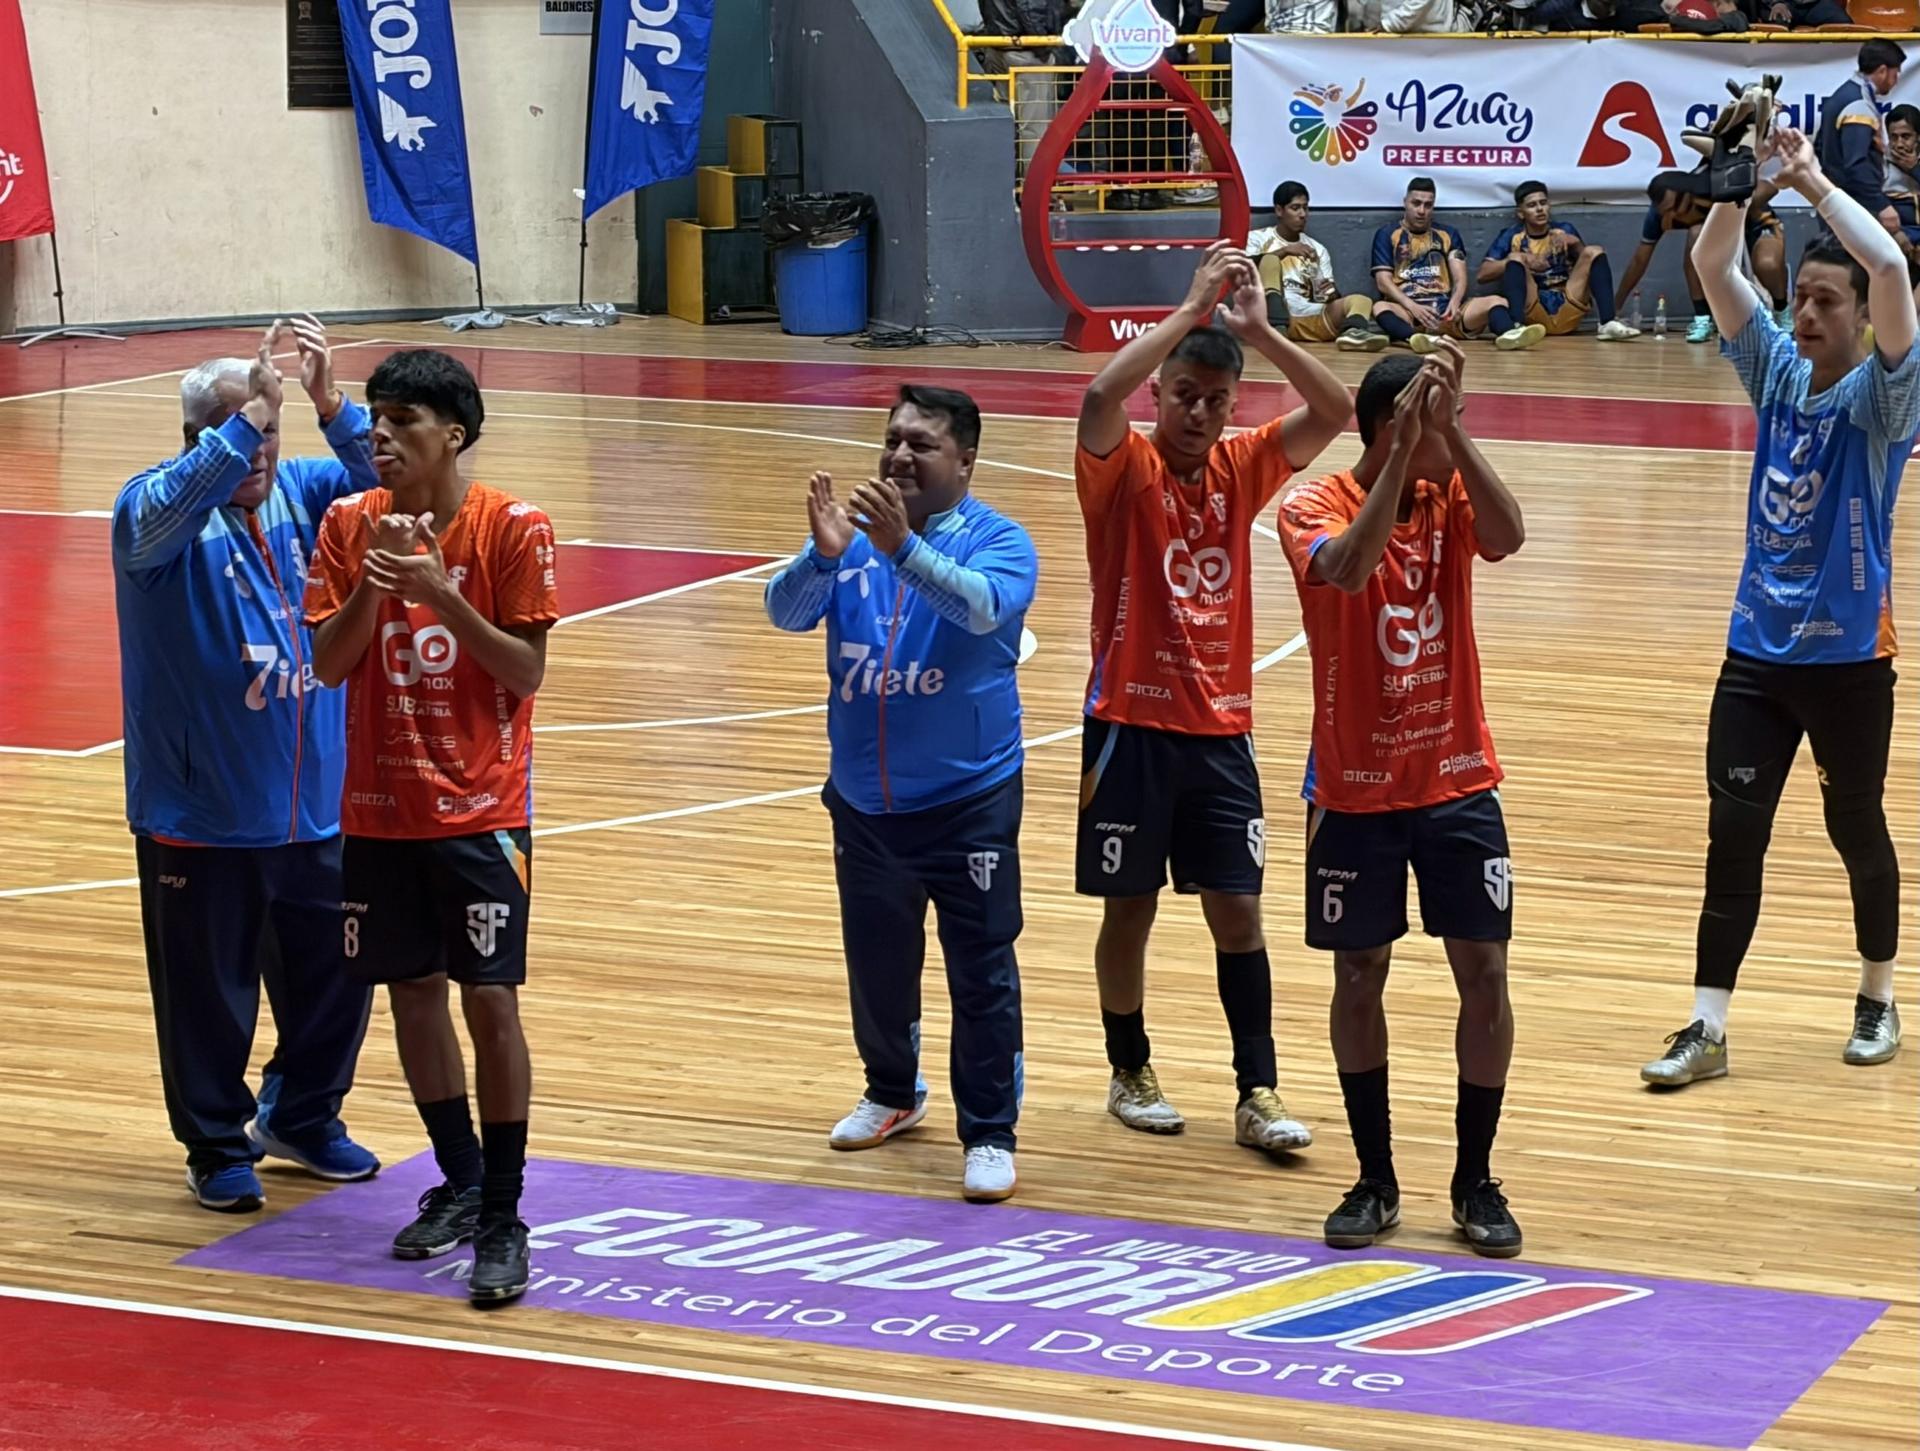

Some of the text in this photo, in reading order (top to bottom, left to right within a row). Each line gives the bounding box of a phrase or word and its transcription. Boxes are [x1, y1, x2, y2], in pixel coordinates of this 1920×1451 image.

[367, 0, 432, 89] JO
[1099, 24, 1171, 44] Vivant
[1386, 149, 1530, 164] PREFECTURA
[839, 642, 944, 703] 7iete
[1095, 822, 1137, 833] RPM
[1102, 837, 1122, 874] 9
[1317, 867, 1359, 881] RPM
[1323, 883, 1344, 924] 6
[344, 917, 359, 957] 8
[997, 1230, 1312, 1275] EL NUEVO
[870, 1313, 1016, 1346] del
[1029, 1330, 1406, 1393] Deporte
